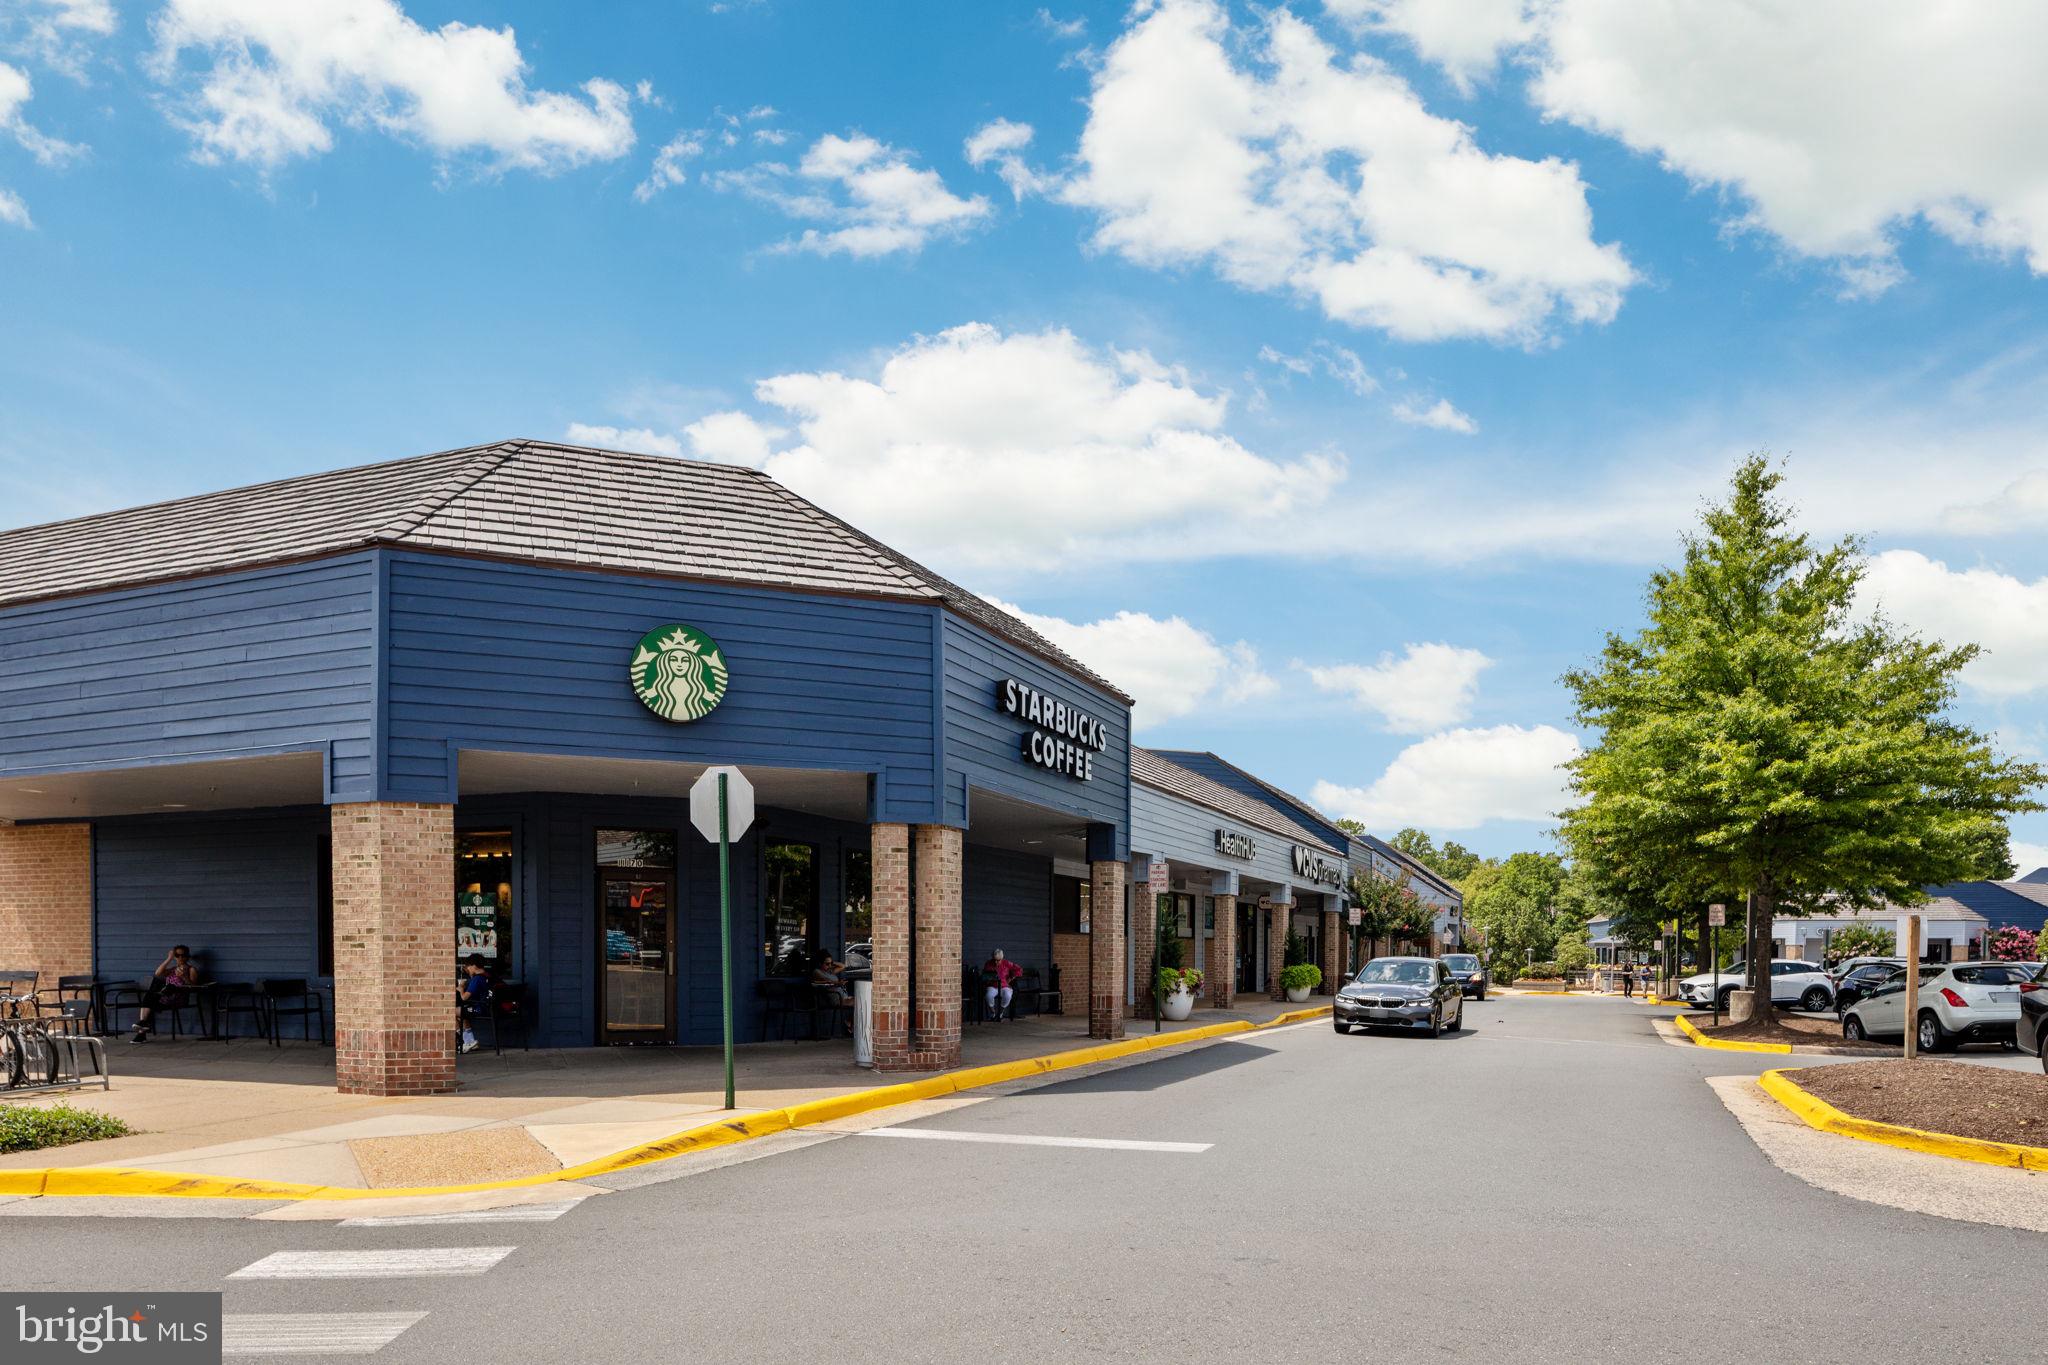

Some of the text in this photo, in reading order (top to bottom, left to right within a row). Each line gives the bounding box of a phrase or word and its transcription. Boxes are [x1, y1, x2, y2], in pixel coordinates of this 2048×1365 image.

[1006, 679, 1107, 752] STARBUCKS
[1031, 730, 1093, 781] COFFEE
[1220, 829, 1257, 861] HealthHUB
[617, 858, 644, 868] 11170
[1303, 848, 1341, 886] CVS pharmacy
[460, 906, 477, 915] WE'RE
